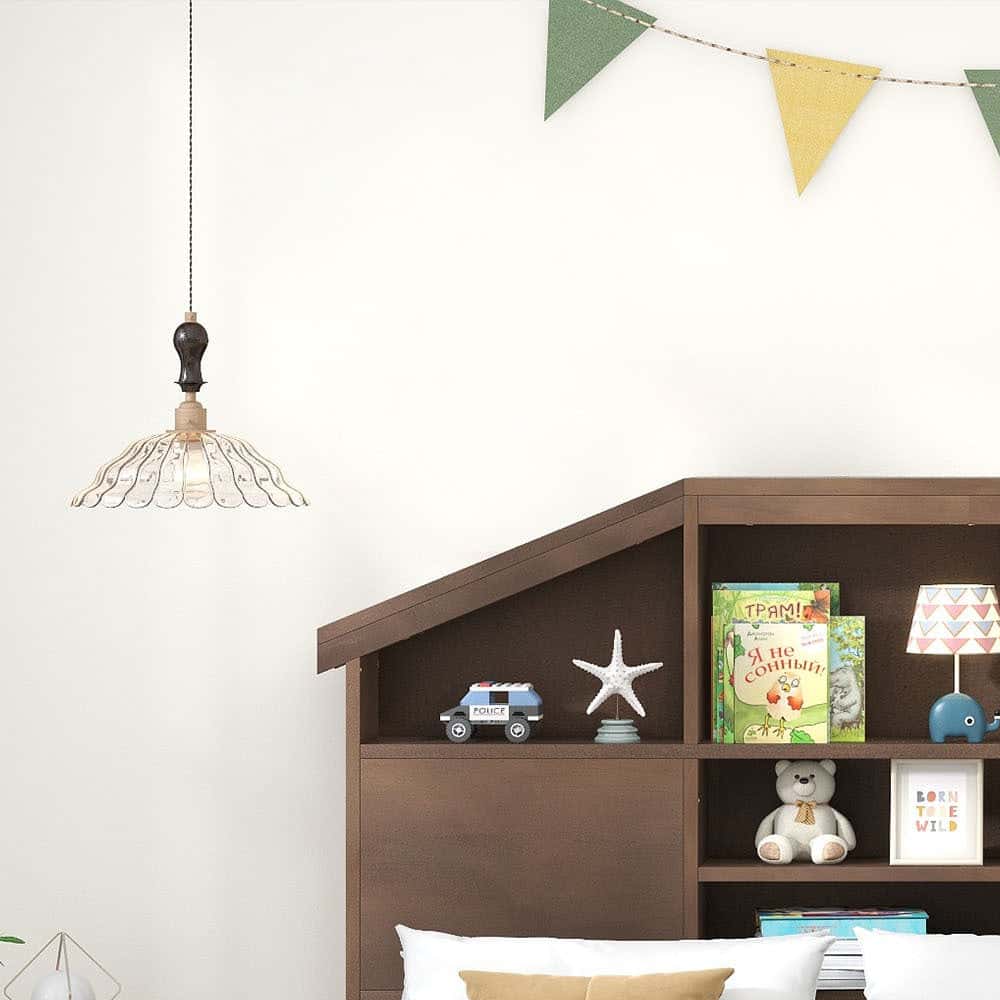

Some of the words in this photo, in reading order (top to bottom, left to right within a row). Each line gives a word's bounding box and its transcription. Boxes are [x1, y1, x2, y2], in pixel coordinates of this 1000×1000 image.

[747, 648, 764, 667] Я
[916, 790, 958, 803] BORN
[916, 820, 958, 832] WILD
